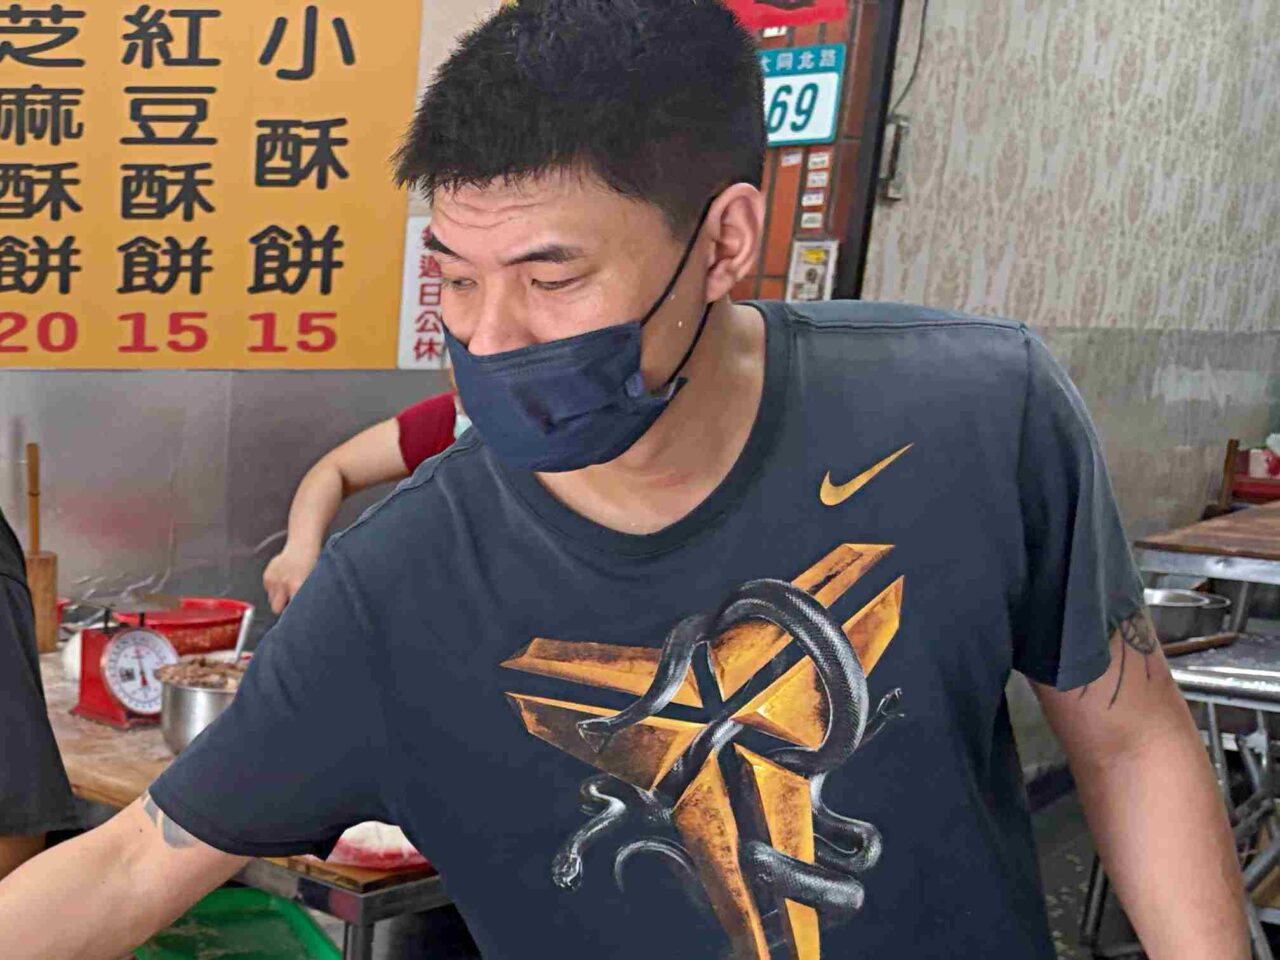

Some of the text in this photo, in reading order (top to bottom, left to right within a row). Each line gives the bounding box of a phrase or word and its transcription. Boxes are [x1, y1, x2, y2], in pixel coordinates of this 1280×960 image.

[766, 82, 819, 133] 69
[117, 5, 221, 296] 紅豆酥餅
[247, 5, 356, 296] 小酥餅
[117, 311, 209, 353] 15
[247, 311, 338, 353] 15
